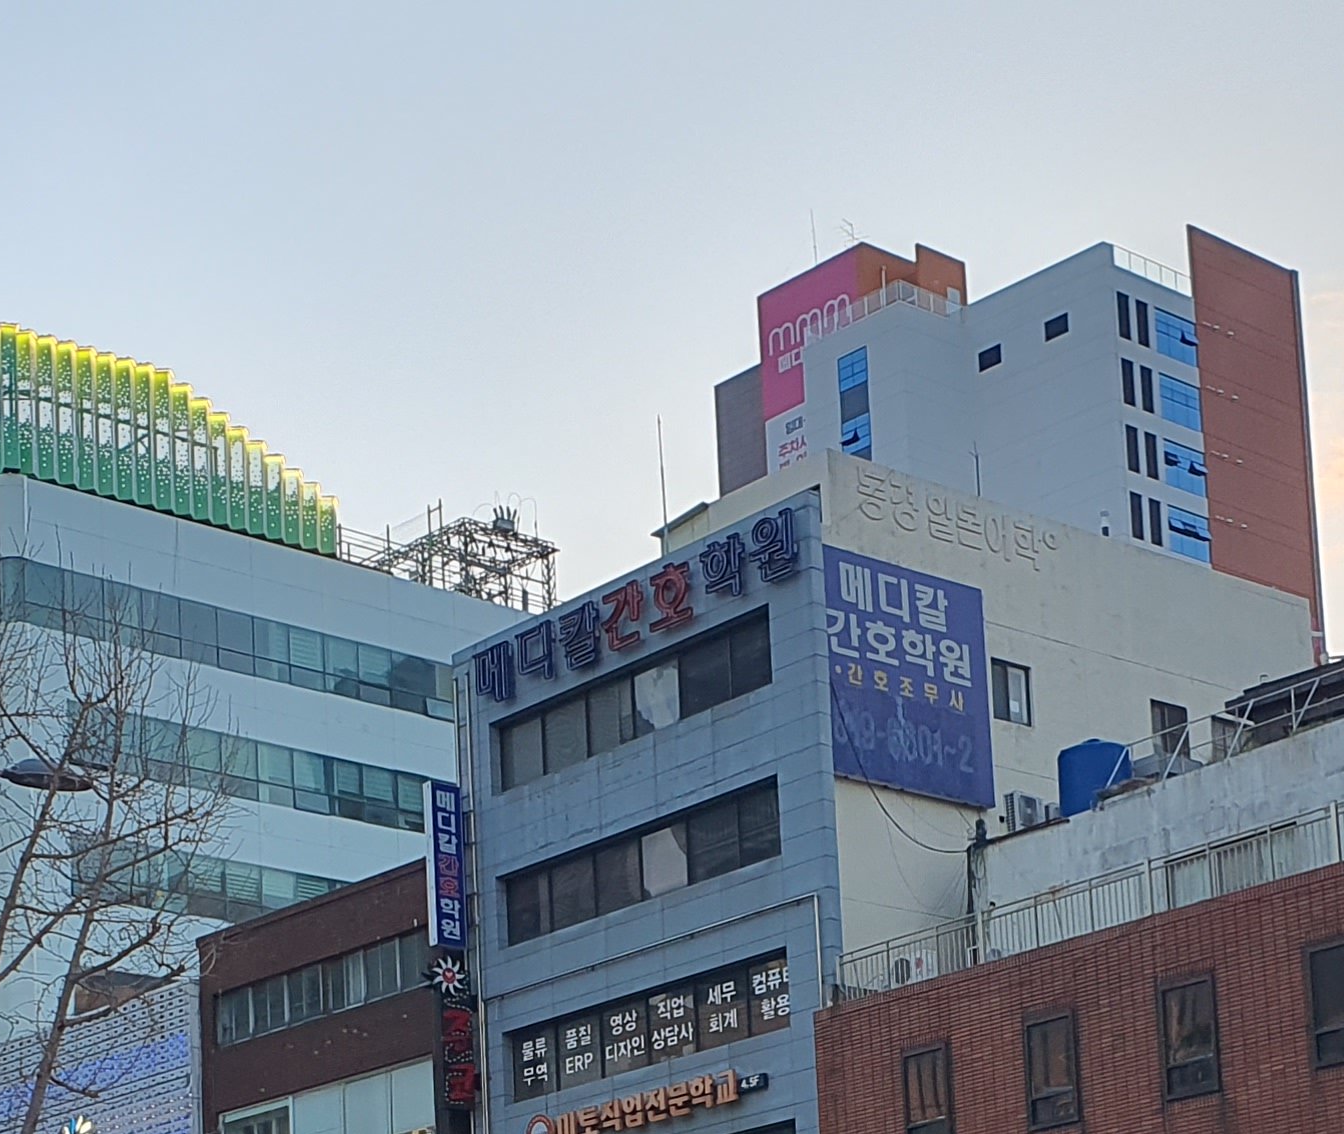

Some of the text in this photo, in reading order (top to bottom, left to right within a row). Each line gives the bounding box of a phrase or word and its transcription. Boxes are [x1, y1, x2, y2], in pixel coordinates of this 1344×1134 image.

[838, 560, 949, 633] 메디칼
[826, 608, 973, 688] 간호학원
[846, 662, 965, 713] 간호조무사
[707, 981, 737, 1006] 세무
[657, 996, 685, 1021] 직업
[708, 1008, 739, 1034] 회계
[761, 994, 791, 1021] 활용
[609, 1009, 638, 1036] 영상
[651, 1021, 695, 1050] 상담사
[521, 1037, 548, 1062] 물류
[564, 1023, 592, 1050] 품질
[606, 1034, 646, 1062] 디자인
[522, 1062, 549, 1087] 무역
[565, 1052, 594, 1075] ERP
